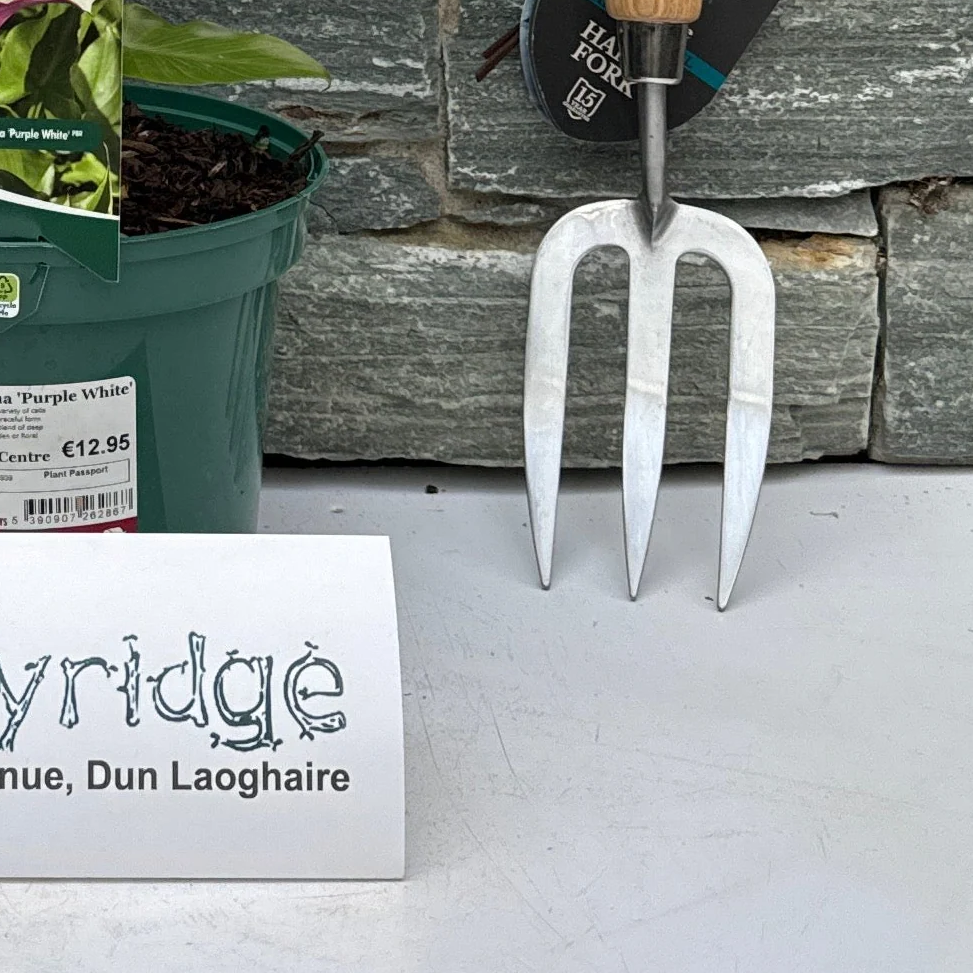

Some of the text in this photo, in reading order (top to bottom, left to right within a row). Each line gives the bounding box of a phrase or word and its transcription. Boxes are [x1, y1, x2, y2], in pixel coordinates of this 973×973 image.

[570, 41, 633, 99] FORK
[574, 85, 598, 108] 15
[8, 128, 39, 141] 'Purple
[41, 129, 70, 140] White'
[17, 390, 77, 406] 'Purple
[82, 382, 133, 401] White'
[62, 433, 130, 458] €12.95
[44, 466, 109, 479] Plant Passport
[88, 760, 157, 790] Dun
[172, 760, 350, 798] Laoghaire
